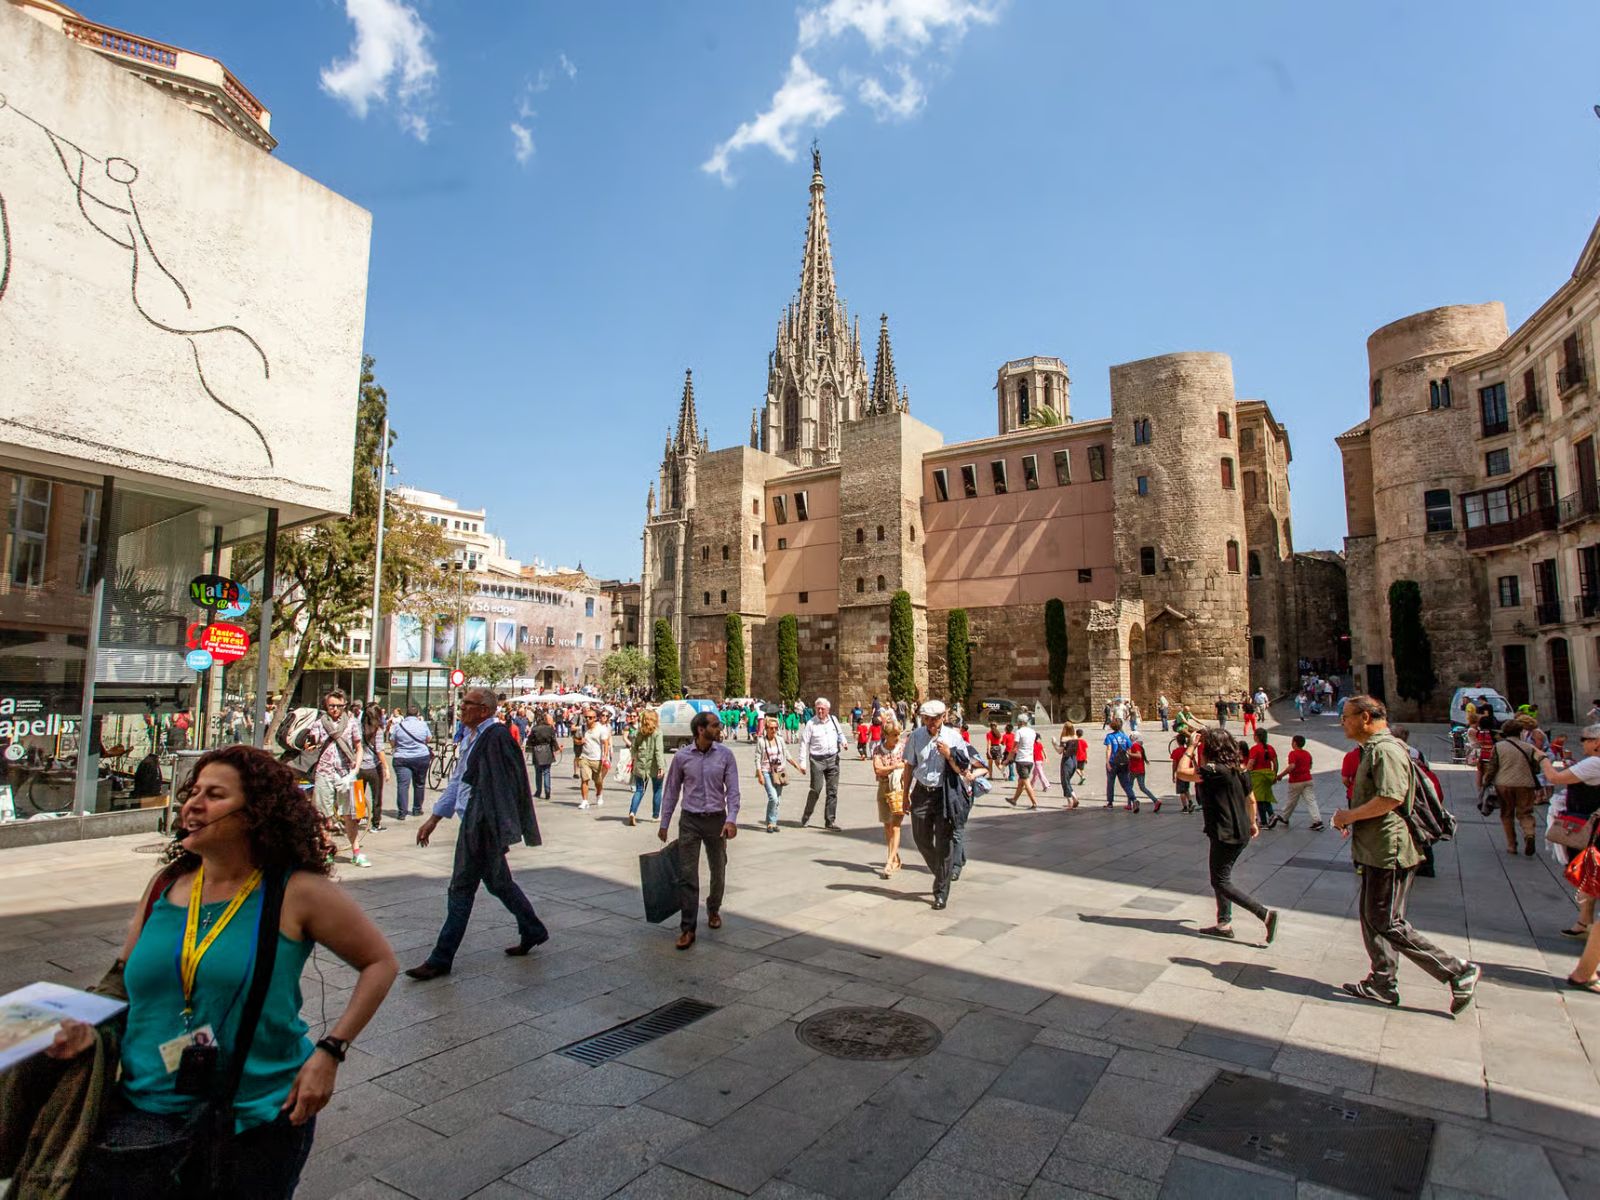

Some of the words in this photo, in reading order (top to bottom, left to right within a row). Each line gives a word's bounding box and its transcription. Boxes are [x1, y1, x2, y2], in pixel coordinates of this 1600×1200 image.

[491, 604, 515, 616] edge
[210, 627, 234, 637] Taste
[523, 635, 544, 645] NEXT
[547, 637, 555, 646] IS
[559, 638, 577, 648] NOW
